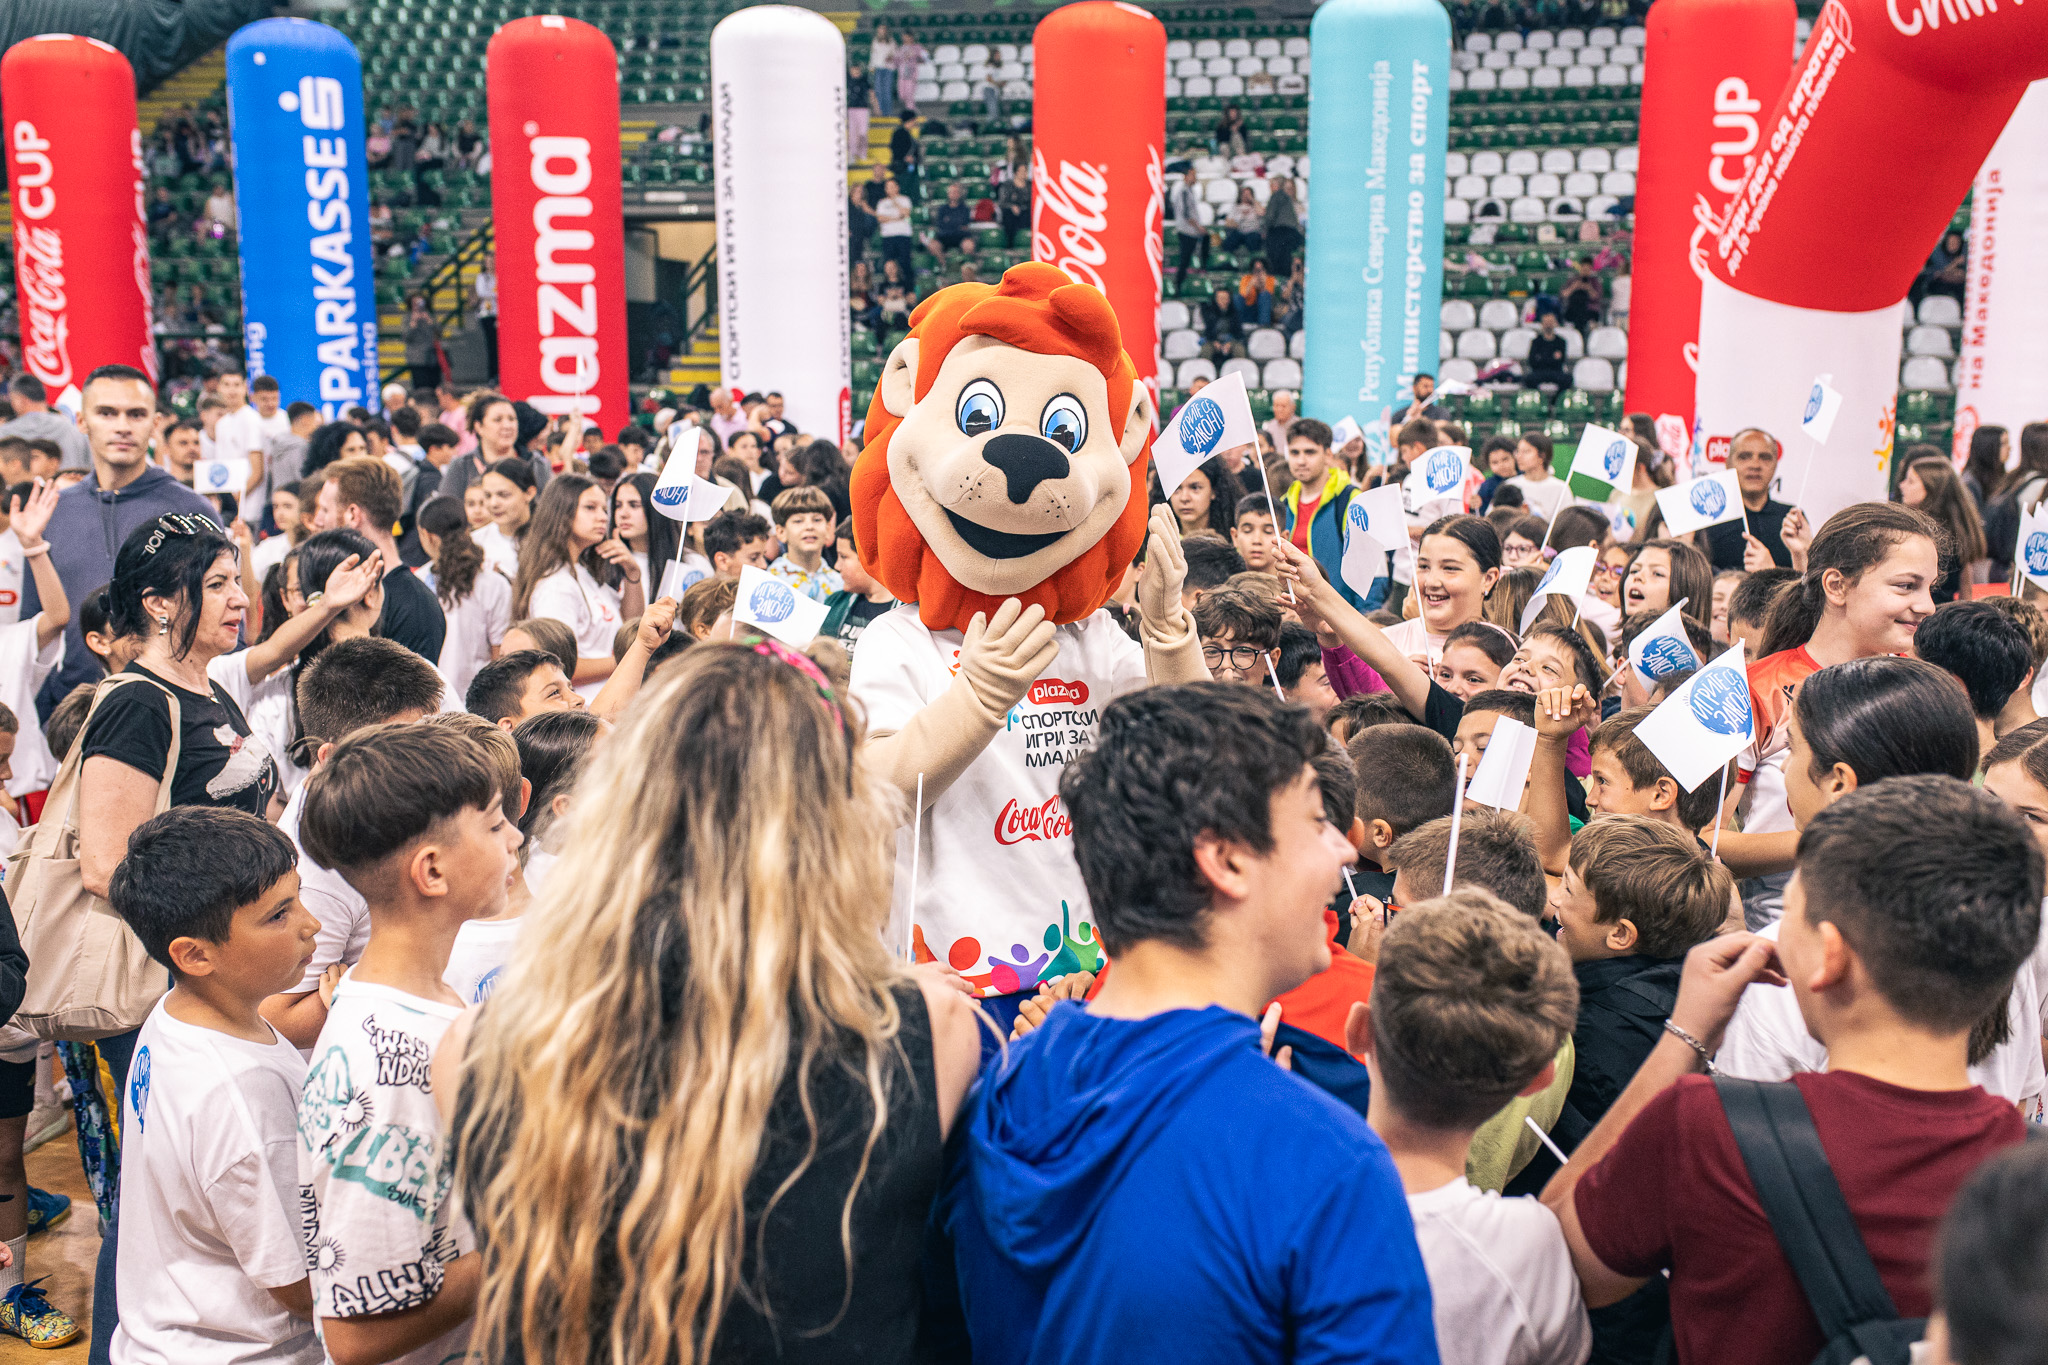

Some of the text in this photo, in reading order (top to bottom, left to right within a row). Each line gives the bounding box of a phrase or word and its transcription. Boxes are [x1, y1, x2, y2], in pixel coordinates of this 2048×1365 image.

[1708, 76, 1762, 195] CUP
[1748, 150, 1773, 207] дел
[1771, 114, 1794, 153] од
[1788, 25, 1835, 118] играта
[1773, 113, 1810, 181] нашата
[1804, 42, 1846, 118] планета
[14, 120, 56, 220] CUP
[303, 134, 362, 425] SPARKASSE
[526, 136, 602, 415] lazma
[1358, 60, 1395, 402] Република Северна Македонија
[1396, 58, 1433, 402] Министерство за спорт
[1969, 168, 2005, 391] на Македонија
[361, 321, 381, 416] easing
[1180, 402, 1204, 443] ИГРИТЕ
[1188, 407, 1225, 454] ЗАКОН!
[1708, 438, 1731, 462] pla
[1641, 647, 1676, 676] ЗАКО
[1656, 636, 1693, 668] ИГРИТЕ
[1690, 672, 1731, 720] ИГРИТЕ
[1025, 729, 1091, 749] ИГРИ ЗА
